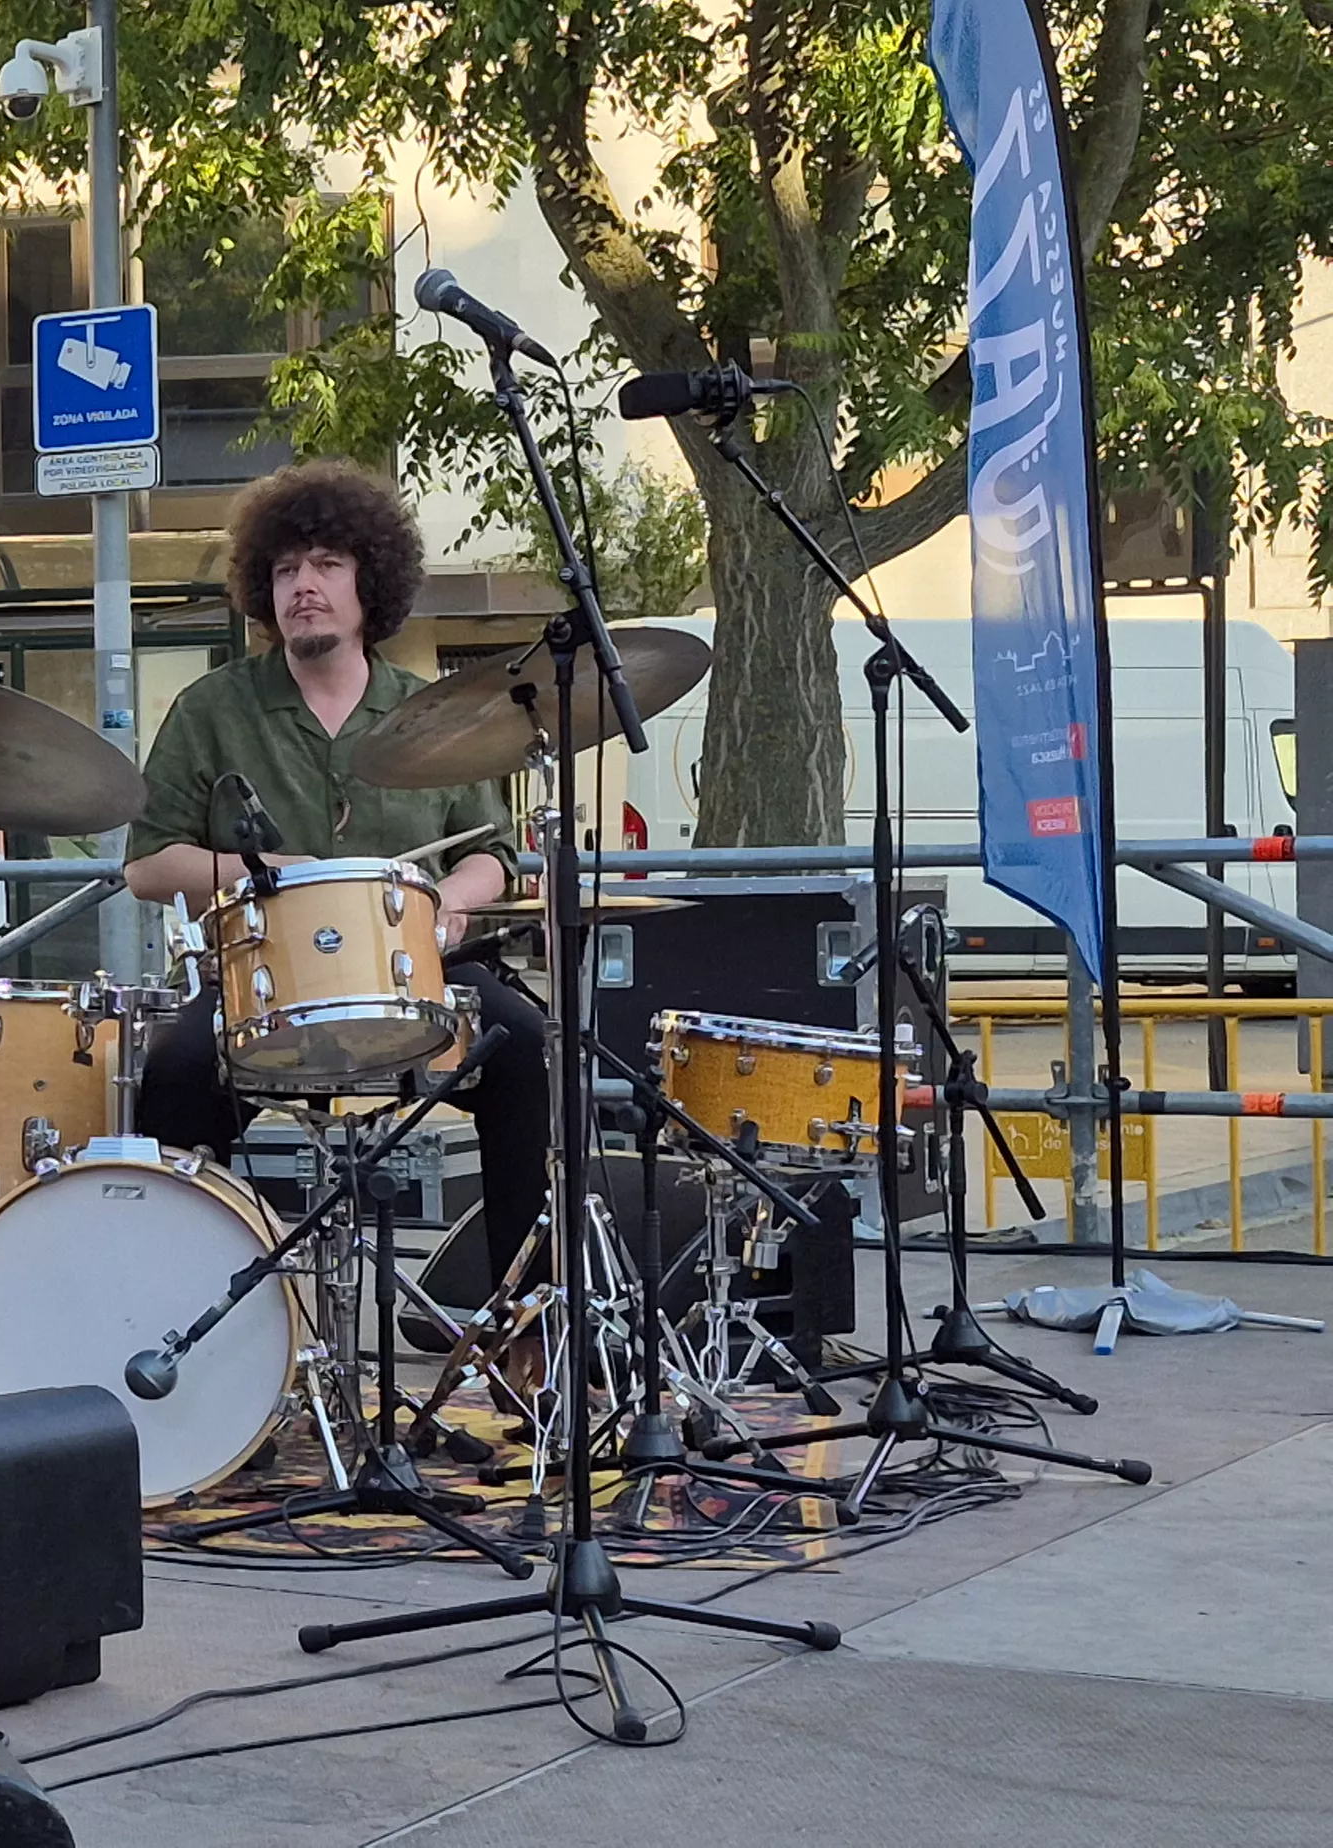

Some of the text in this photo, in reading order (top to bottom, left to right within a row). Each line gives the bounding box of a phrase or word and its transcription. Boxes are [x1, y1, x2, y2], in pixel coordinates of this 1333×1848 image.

[53, 408, 138, 426] ZONA VIGILADA
[43, 467, 64, 477] POR
[100, 478, 133, 488] LOCAL
